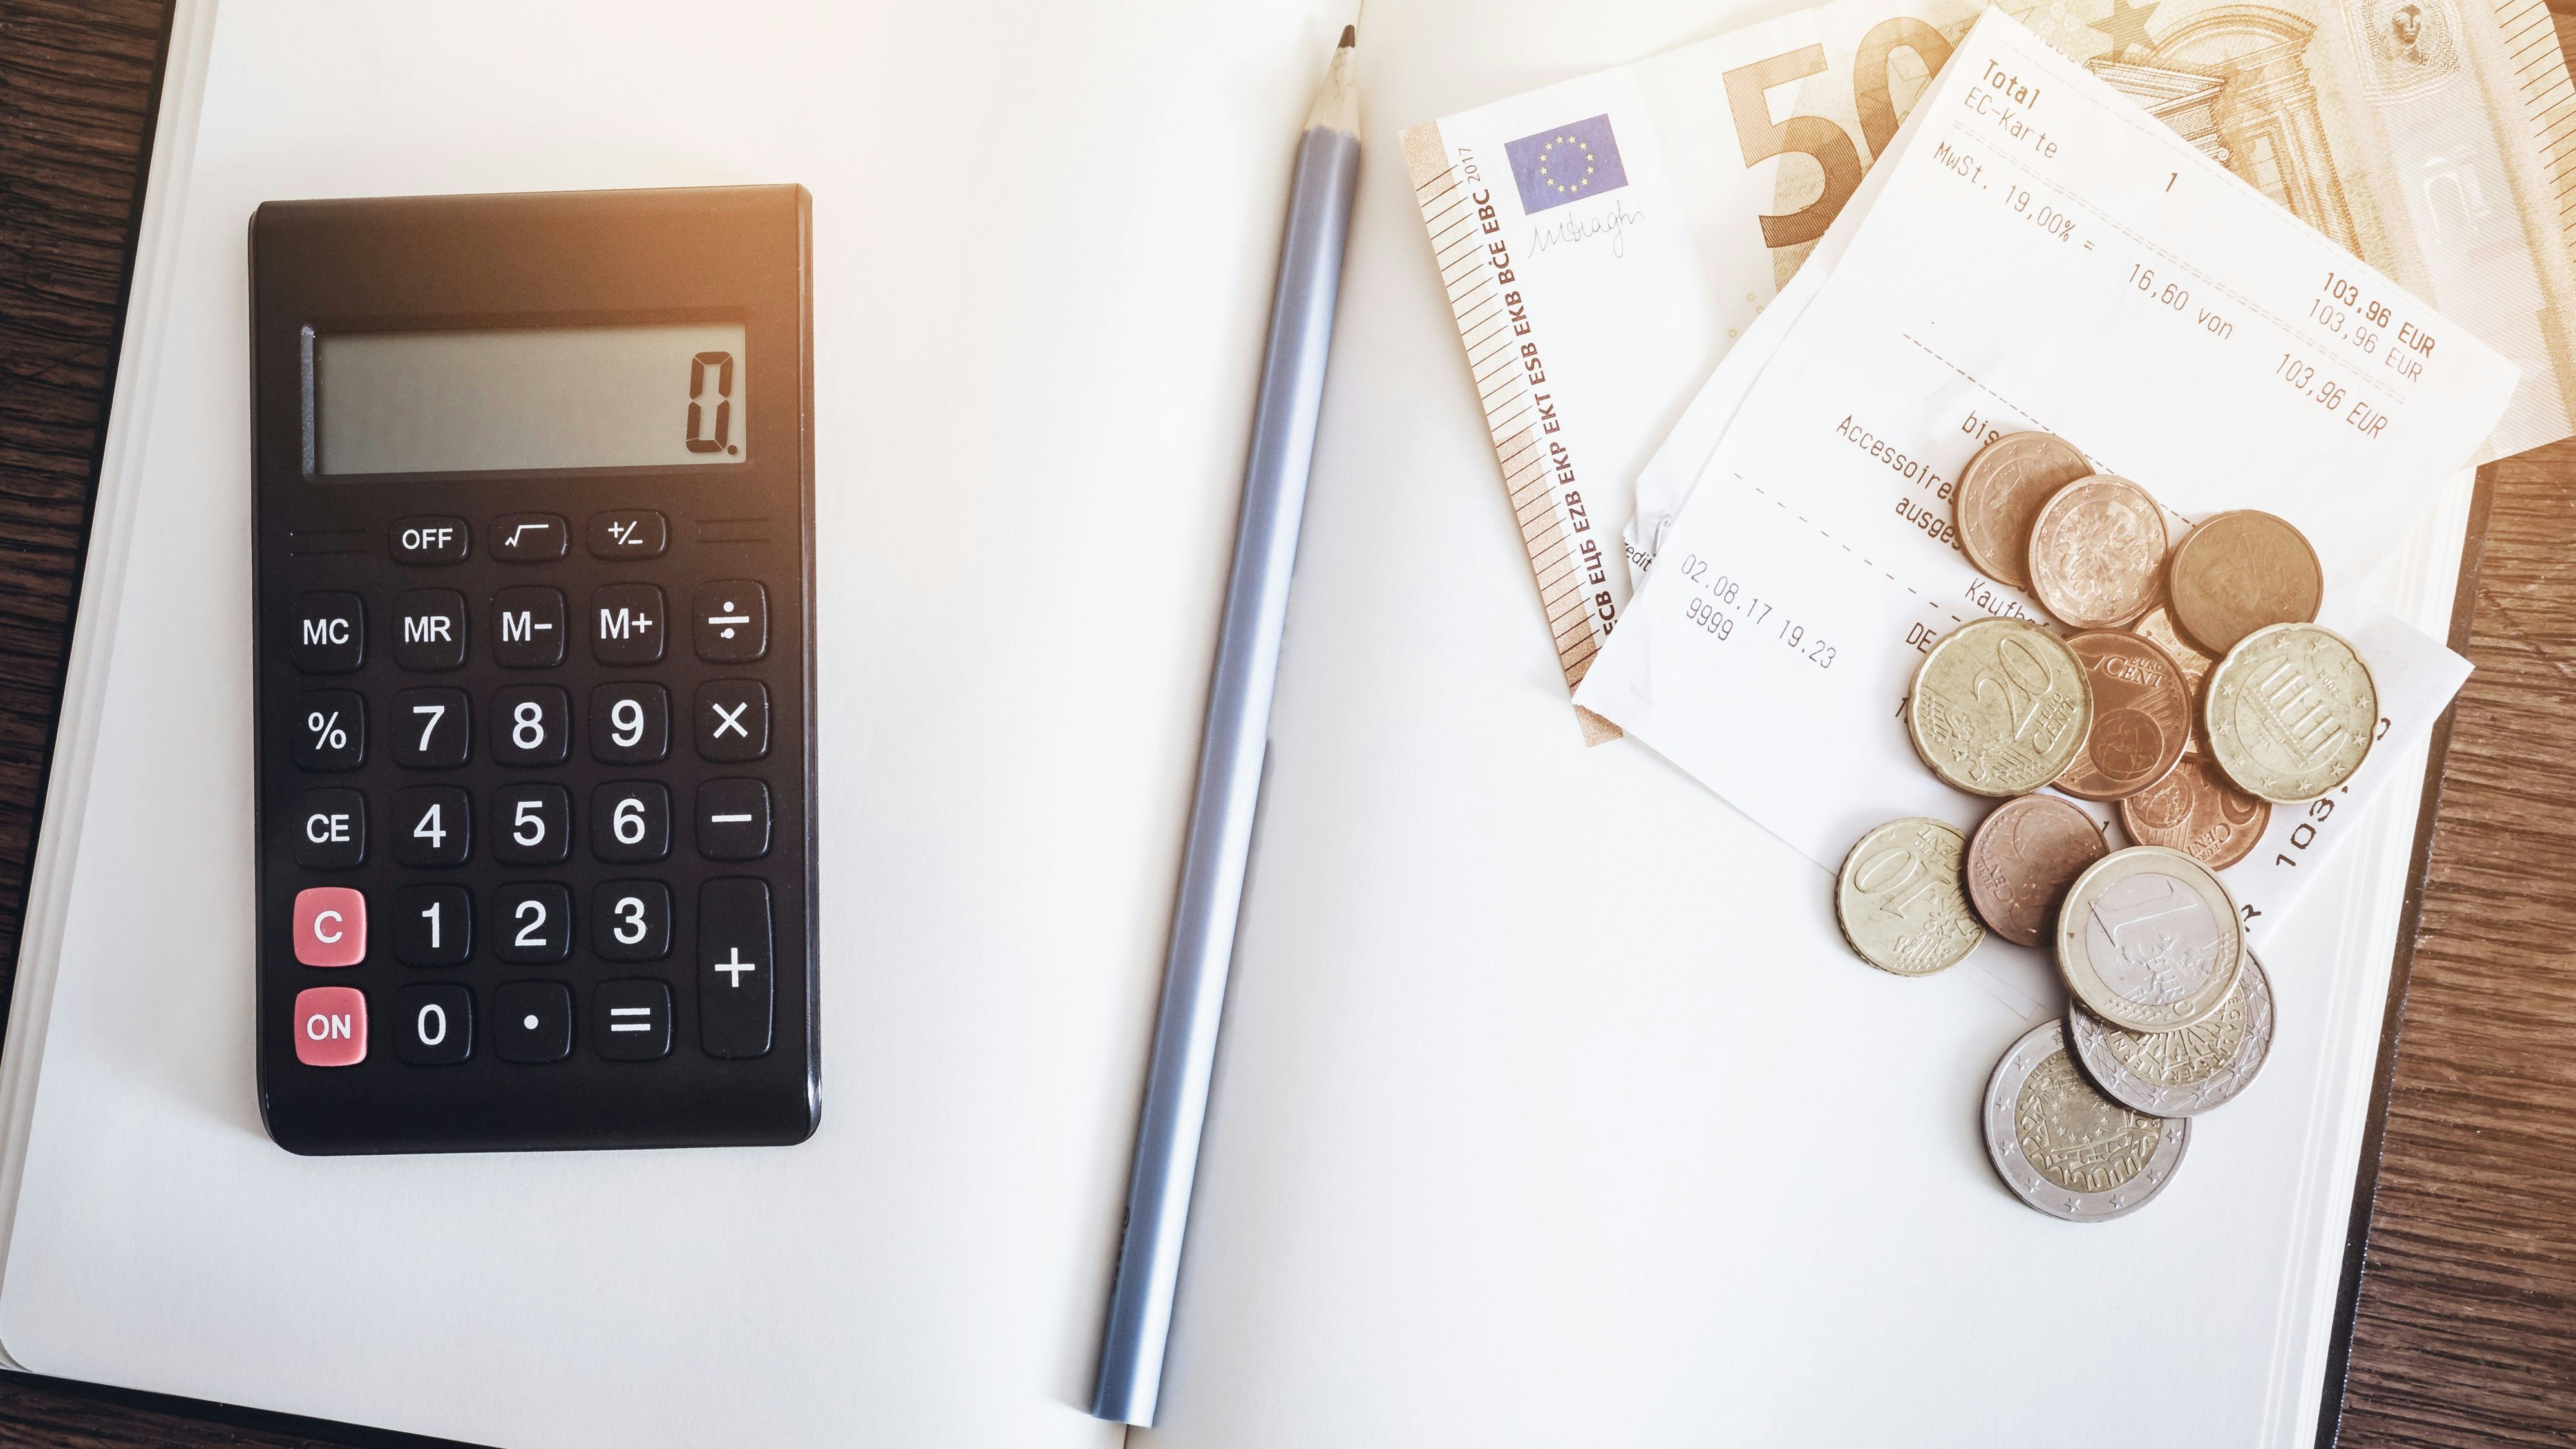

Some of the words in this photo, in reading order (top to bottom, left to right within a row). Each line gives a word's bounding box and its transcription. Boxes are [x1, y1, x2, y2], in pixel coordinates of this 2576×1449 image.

[1984, 59, 2040, 109] Total
[1964, 86, 2058, 158] EC-Karte
[1458, 147, 1481, 185] 2017
[2166, 173, 2178, 193] 1
[1472, 189, 1500, 234] EBC
[1933, 140, 1987, 189] MwSt.
[2005, 185, 2076, 242] 19,00%
[2129, 263, 2189, 310] 16,60
[2198, 307, 2233, 340] von
[2276, 354, 2346, 410] 103,96
[2346, 401, 2388, 439] EUR
[1504, 291, 1531, 336] EKB
[2324, 272, 2392, 328] 103,96
[2398, 321, 2436, 358] EUR
[2309, 299, 2379, 354] 103,96
[2385, 347, 2423, 383] EUR
[1520, 342, 1546, 386] ESB
[1534, 393, 1560, 435] EKT
[1549, 442, 1575, 485] EKP
[1565, 491, 1591, 533] EZB
[402, 528, 453, 550] OFF
[1595, 591, 1618, 636] ECB
[1681, 554, 1772, 625] 02.08.17
[1779, 620, 1836, 668] 19.23
[1687, 597, 1734, 641] 9999
[1965, 577, 2049, 627] Kaufh
[303, 619, 349, 645] MC
[404, 616, 451, 643] MR
[601, 609, 653, 639] M+
[1906, 622, 1937, 654] DE
[2103, 656, 2168, 688] CENT
[2131, 656, 2165, 672] EURO
[1973, 633, 2053, 741] 20
[308, 712, 346, 750] %
[413, 706, 445, 752] 7
[513, 702, 544, 750] 8
[612, 699, 644, 747] 9
[2032, 696, 2078, 755] CENT
[307, 814, 350, 844] CE
[413, 804, 446, 848] 4
[513, 800, 545, 846] 5
[613, 799, 645, 844] 6
[314, 911, 343, 943] C
[422, 902, 440, 948] 1
[515, 901, 547, 947] 2
[613, 897, 647, 944] 3
[307, 1014, 351, 1041] ON
[417, 1004, 446, 1046] 0
